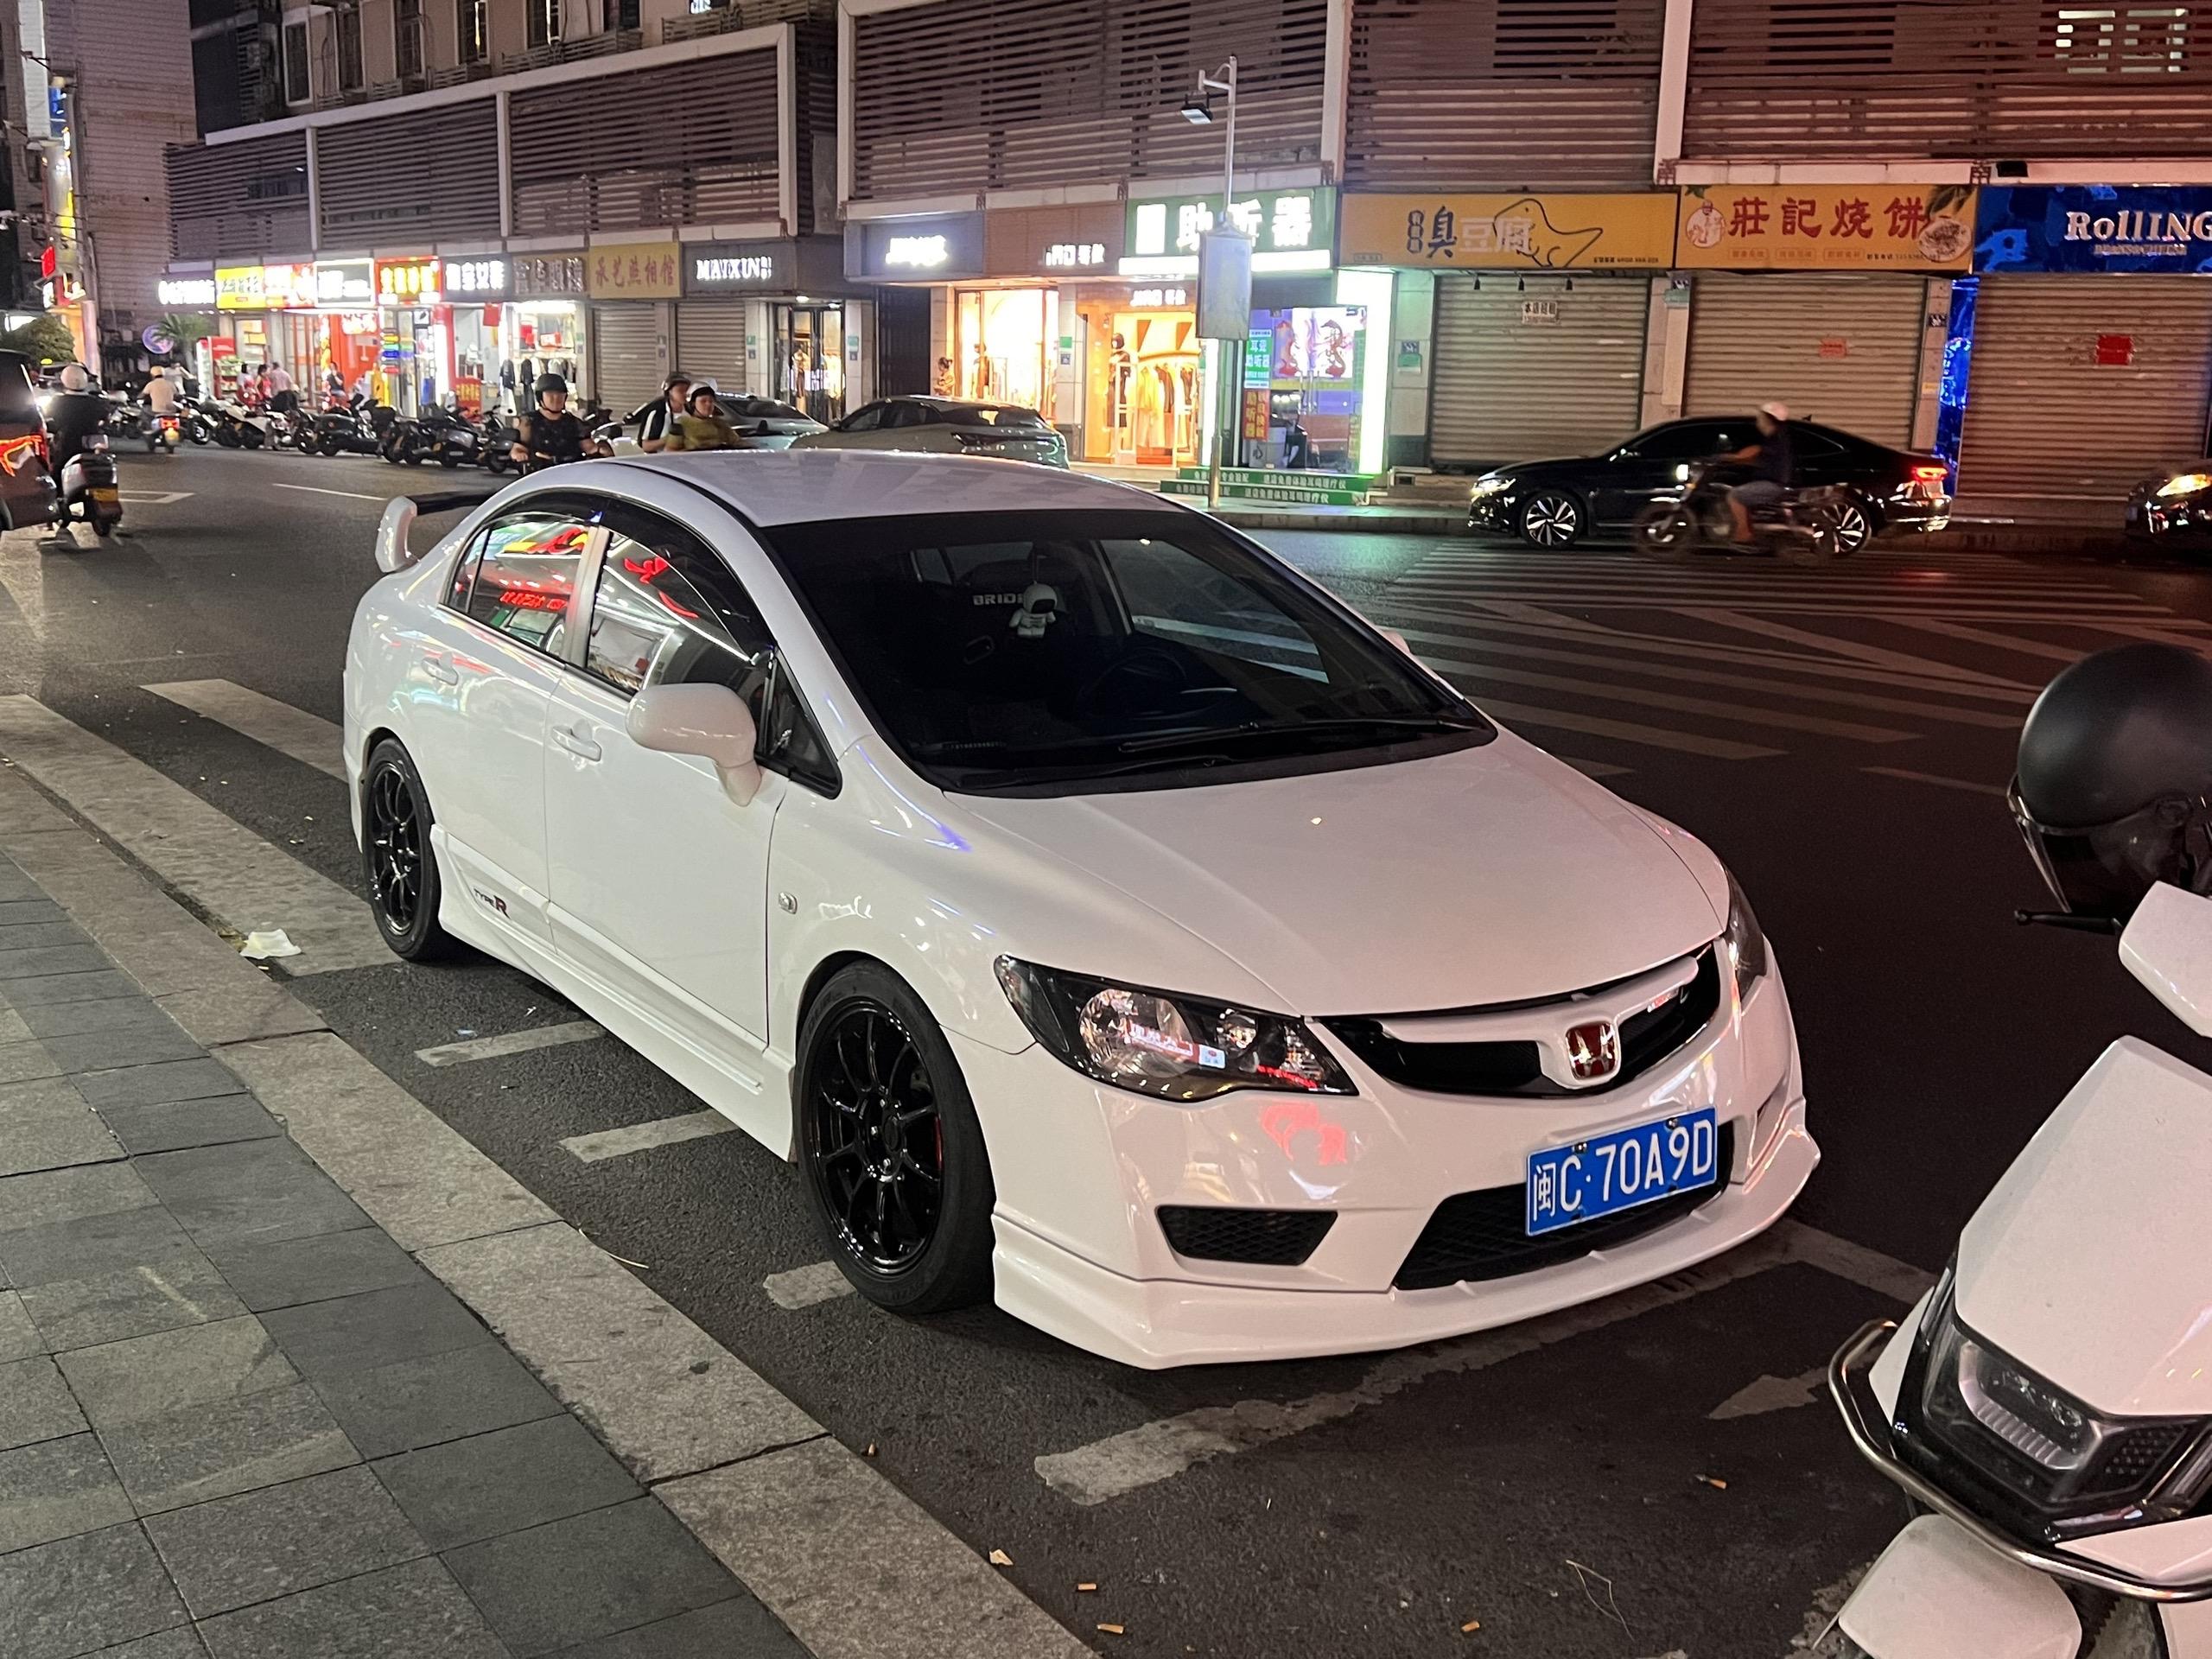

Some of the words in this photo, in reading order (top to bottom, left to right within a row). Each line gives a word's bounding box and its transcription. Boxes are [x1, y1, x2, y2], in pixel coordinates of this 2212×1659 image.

[1728, 196, 1928, 238] 莊記烧饼
[1533, 1120, 1713, 1222] 闽C·70A9D
